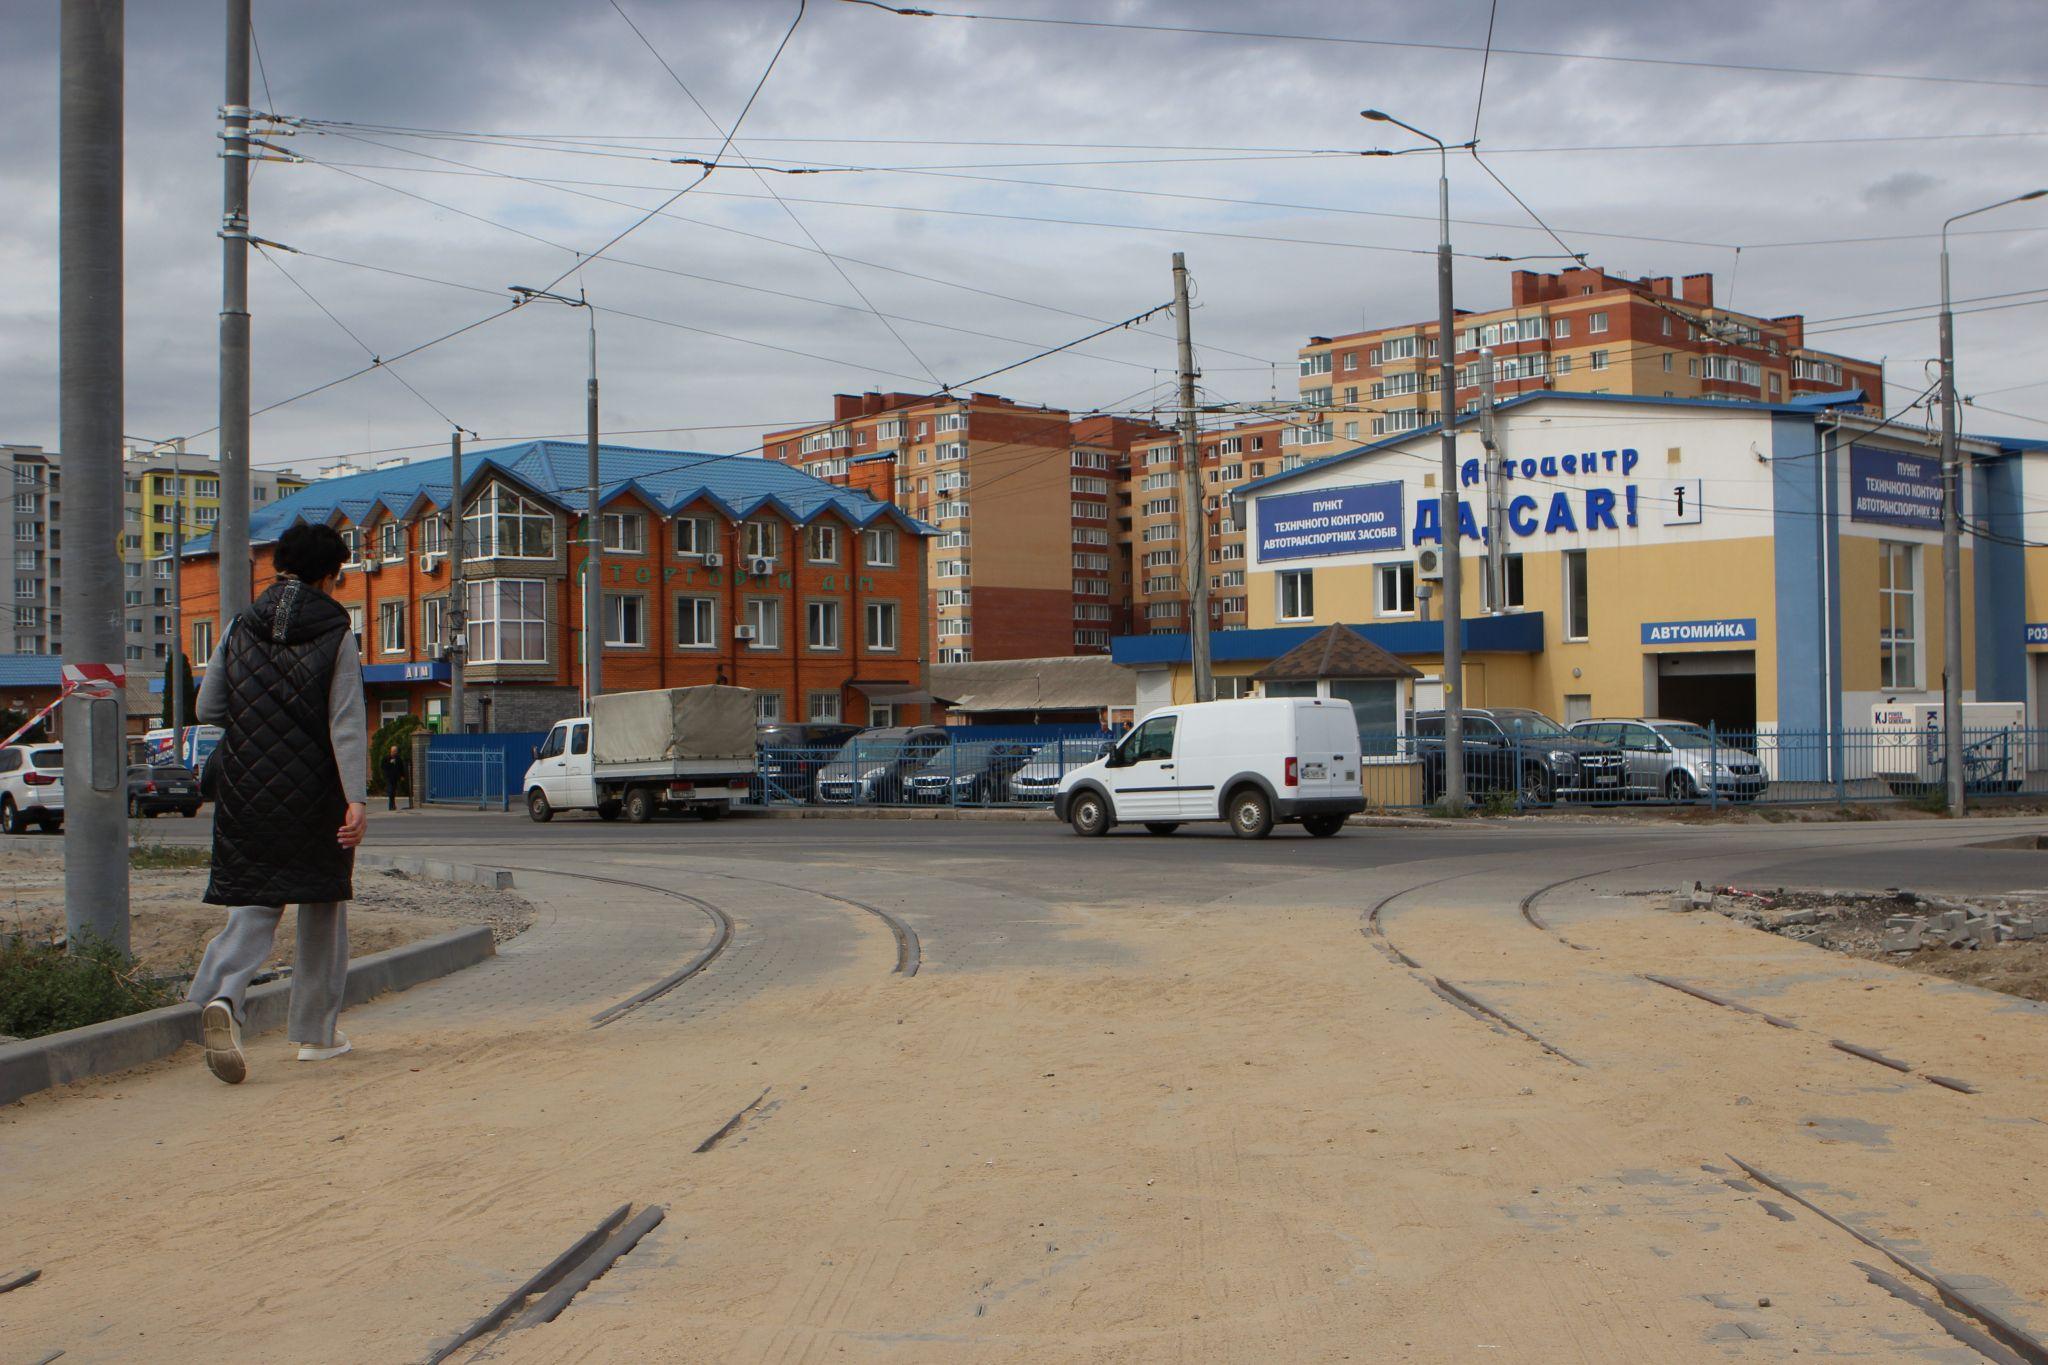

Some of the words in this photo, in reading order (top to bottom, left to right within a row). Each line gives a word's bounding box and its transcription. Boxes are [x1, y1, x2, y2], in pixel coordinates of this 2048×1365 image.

[1461, 448, 1639, 488] Атоцентр
[1897, 462, 1920, 477] ПУНКТ
[1866, 477, 1911, 496] ТЕХНІЧНОГО
[1911, 485, 1944, 500] КОНТРОЛ
[1312, 499, 1343, 512] ПУНКТ
[1508, 484, 1639, 537] CAR!
[1857, 496, 1930, 518] АВТОТРАНСПОРТНИХ
[1274, 517, 1329, 532] ТЕХНІЧНОГО
[1331, 511, 1384, 527] КОНТРОЛЮ
[1263, 531, 1356, 550] АВТОТРАНСПОРТНИХ
[1357, 527, 1397, 541] ЗАСОБІВ
[1650, 622, 1746, 640] АВТОМИЙКА
[1875, 712, 1887, 724] KJ
[1927, 711, 1937, 729] KJ
